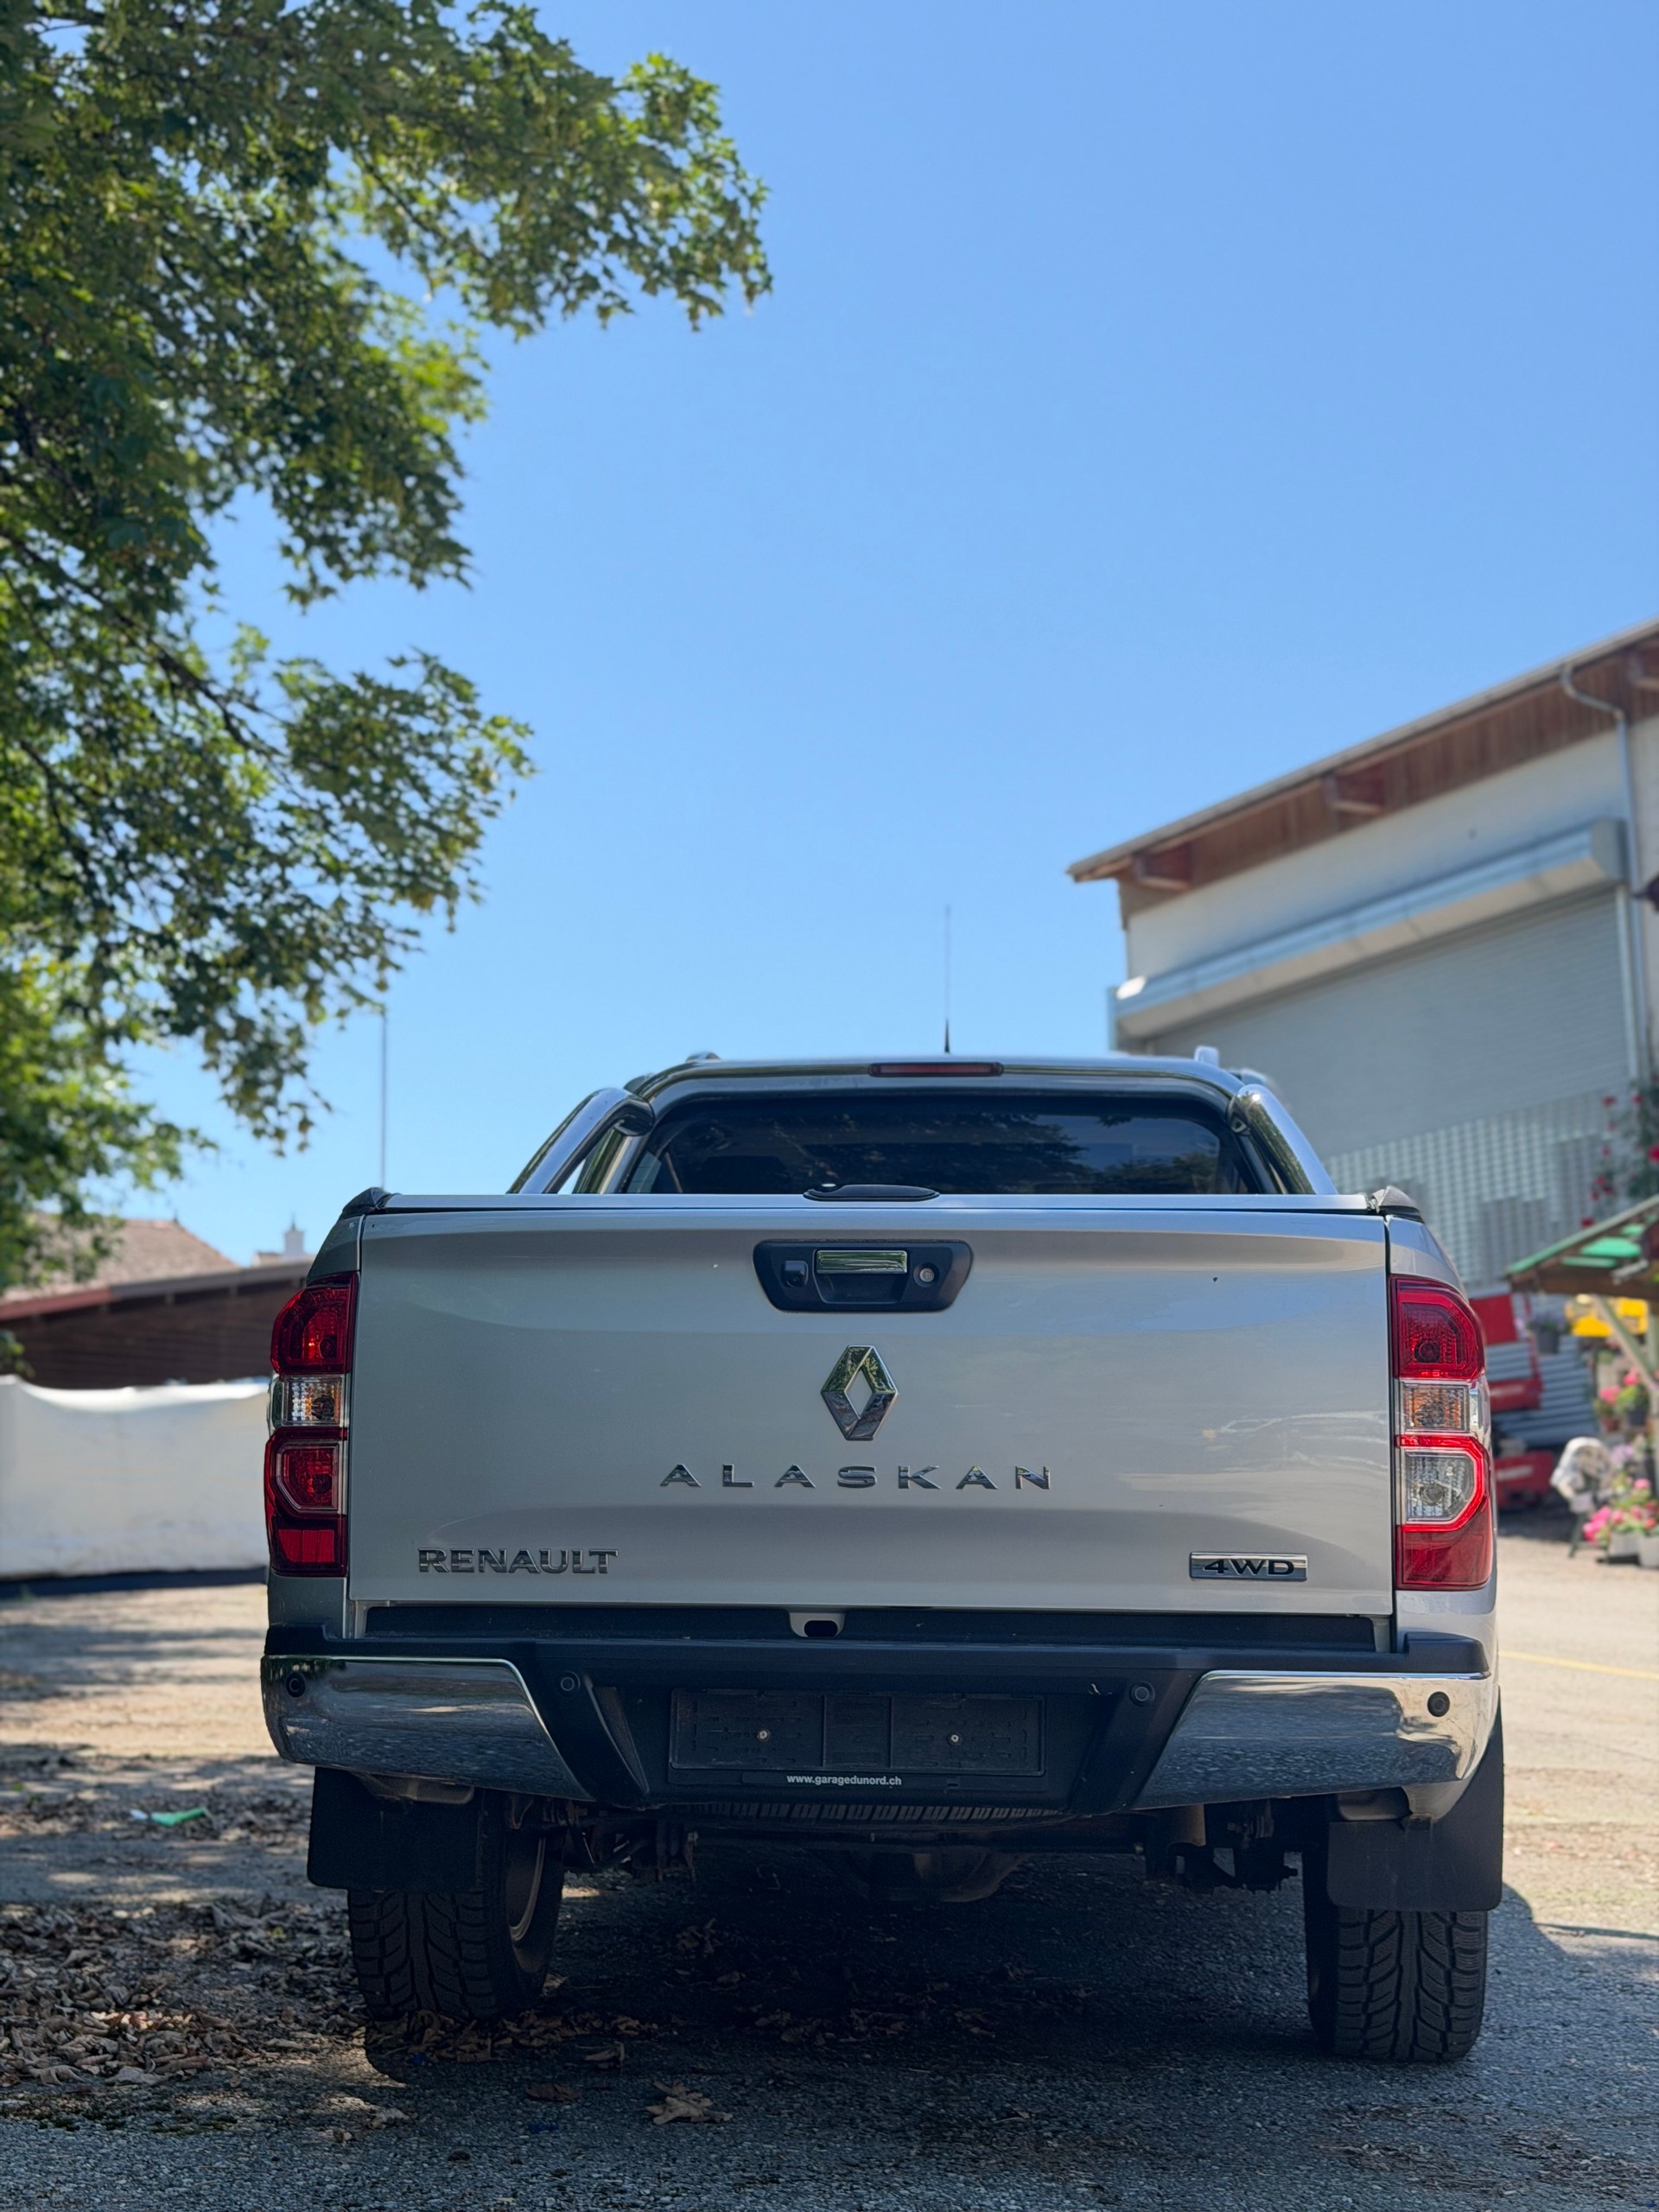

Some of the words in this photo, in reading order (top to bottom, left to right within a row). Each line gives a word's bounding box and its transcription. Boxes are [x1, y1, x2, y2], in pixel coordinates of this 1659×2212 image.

[660, 1464, 1052, 1489] ALASKAN
[418, 1548, 619, 1573] RENAULT
[1204, 1559, 1294, 1575] 4WD
[786, 1774, 902, 1786] www.garagedunord.ch
